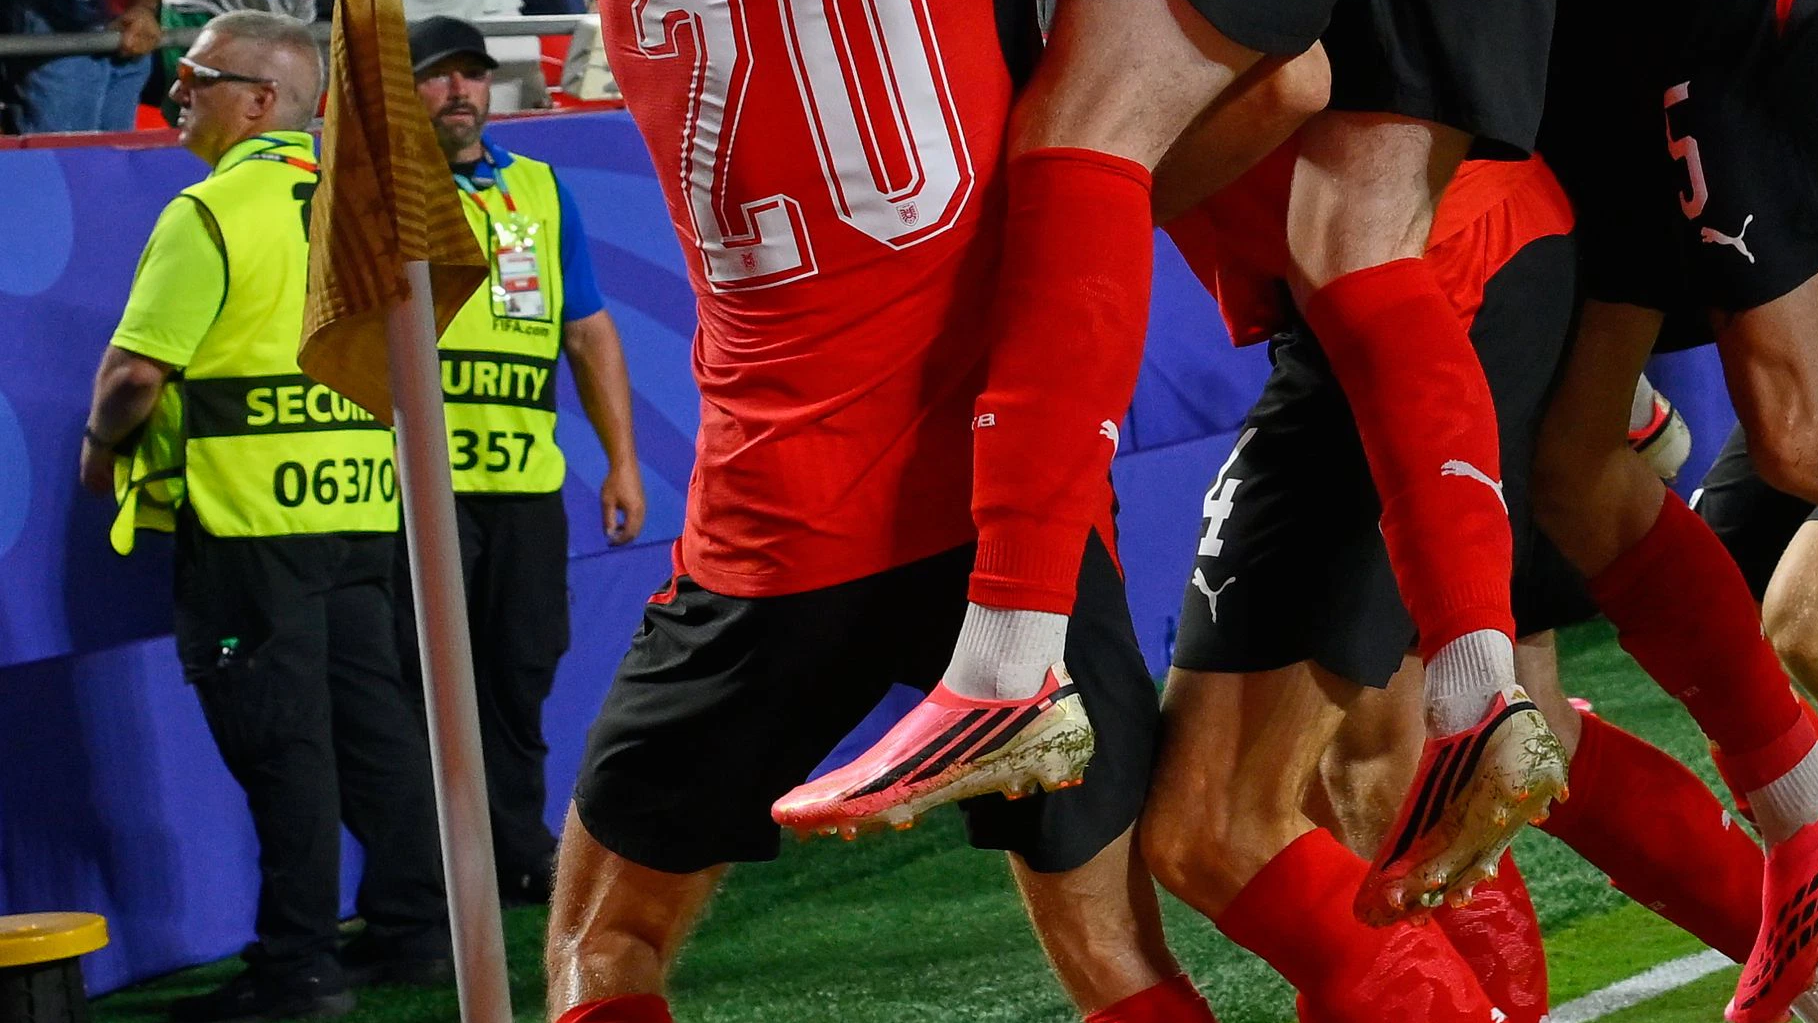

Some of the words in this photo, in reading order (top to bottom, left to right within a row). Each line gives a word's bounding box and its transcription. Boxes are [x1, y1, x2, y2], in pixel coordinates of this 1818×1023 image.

[1663, 80, 1709, 220] 5
[492, 318, 549, 337] FIFA.com
[441, 360, 549, 401] URITY
[246, 383, 375, 427] SECU
[452, 429, 536, 473] 357
[273, 457, 396, 508] 06370
